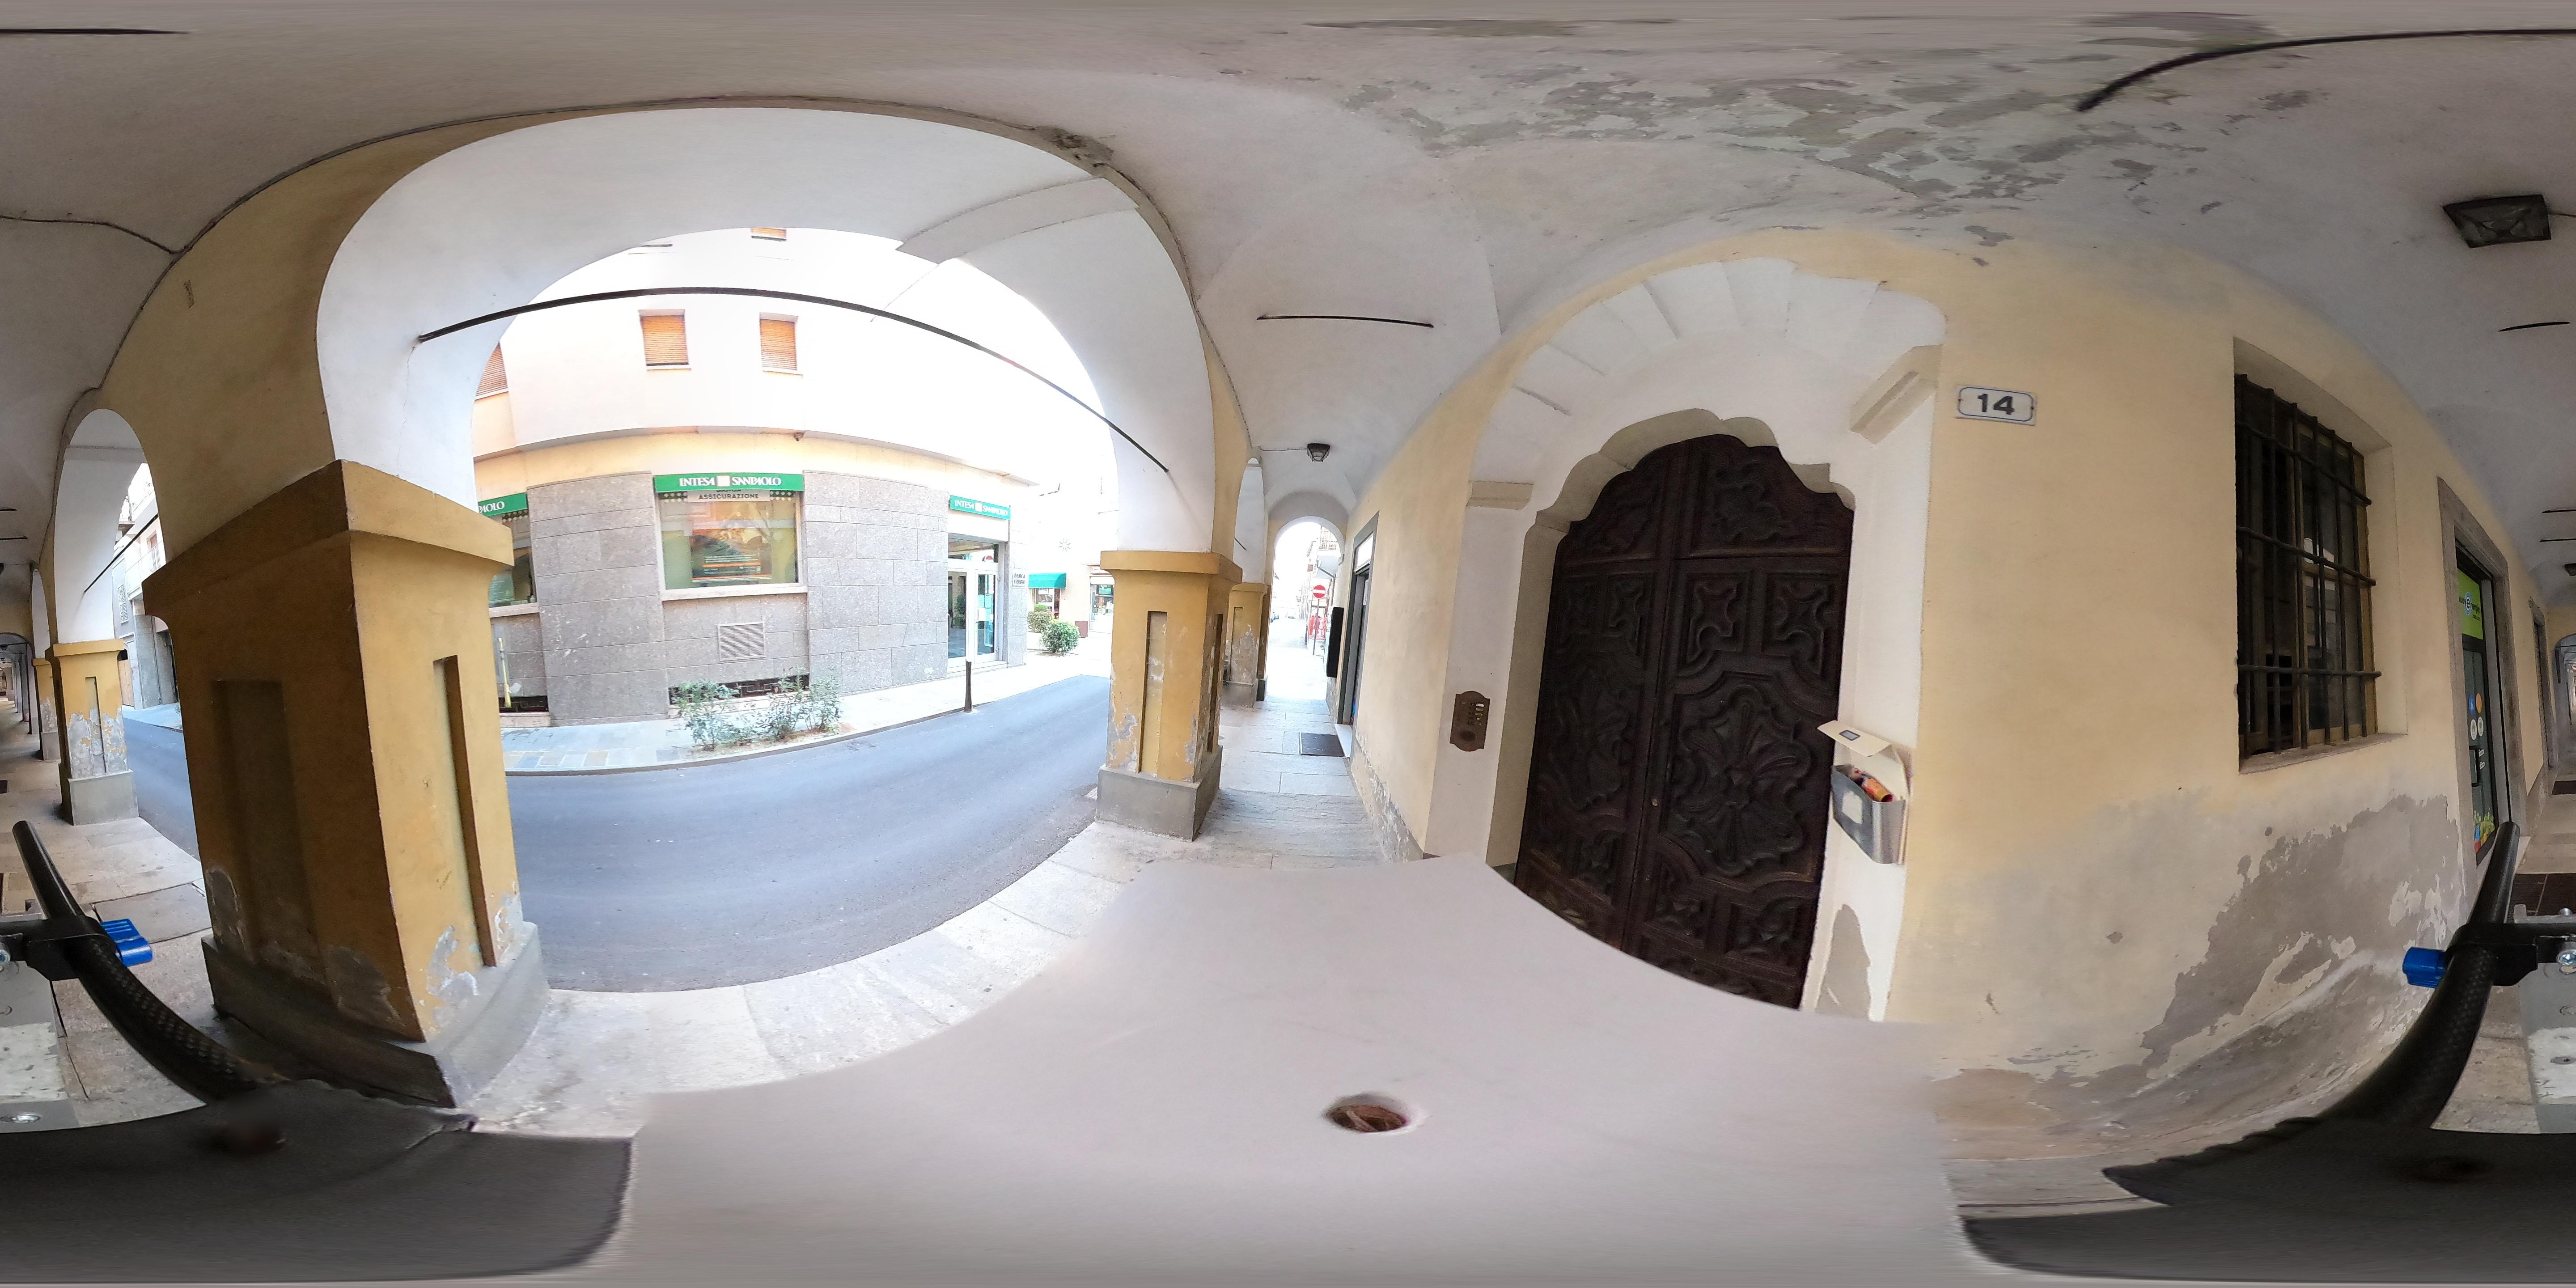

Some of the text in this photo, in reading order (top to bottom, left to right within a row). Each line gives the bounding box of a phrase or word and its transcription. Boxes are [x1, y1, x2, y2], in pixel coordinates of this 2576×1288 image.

[1977, 393, 2014, 415] 14
[679, 476, 782, 487] INTESA SANPAOLO
[954, 500, 974, 509] INTESA
